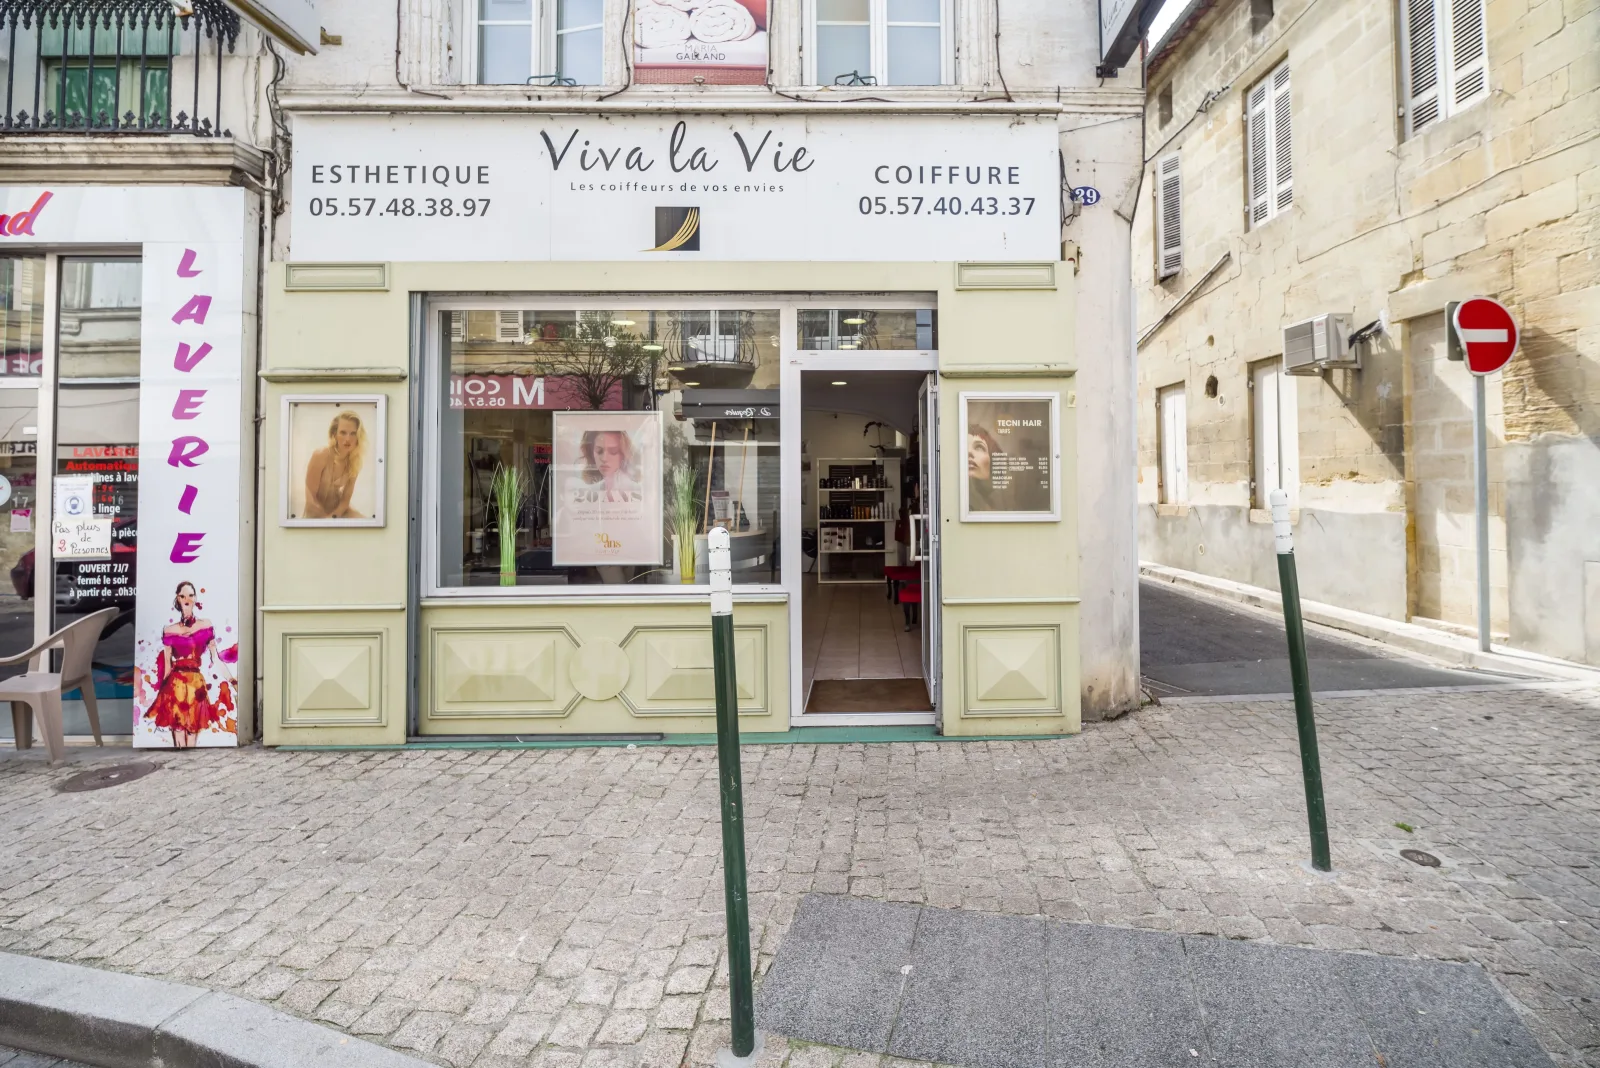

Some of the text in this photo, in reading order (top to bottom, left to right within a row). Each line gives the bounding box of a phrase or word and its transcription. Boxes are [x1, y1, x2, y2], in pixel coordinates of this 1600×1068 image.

[684, 44, 718, 53] MARIA
[675, 52, 726, 61] GALLAND
[540, 120, 815, 173] Viva la Vie
[311, 164, 490, 188] ESTHETIQUE
[874, 165, 1020, 185] COIFFURE
[570, 182, 784, 192] Les coiffeurs de vos envies
[309, 197, 491, 217] 05.57.48.38.97
[858, 196, 1036, 216] 05.57.40.43.37
[166, 248, 214, 564] LAVERIE
[1022, 419, 1042, 427] HAIR
[65, 460, 138, 473] Automatiqu
[116, 472, 122, 482] à
[124, 472, 138, 483] lav
[98, 503, 121, 516] linge
[54, 521, 101, 536] Pas plus
[118, 527, 138, 540] pièc
[79, 563, 112, 573] OUVERT
[77, 575, 129, 585] fermé le soir
[69, 587, 75, 597] à
[76, 587, 100, 599] partir
[101, 586, 112, 597] de
